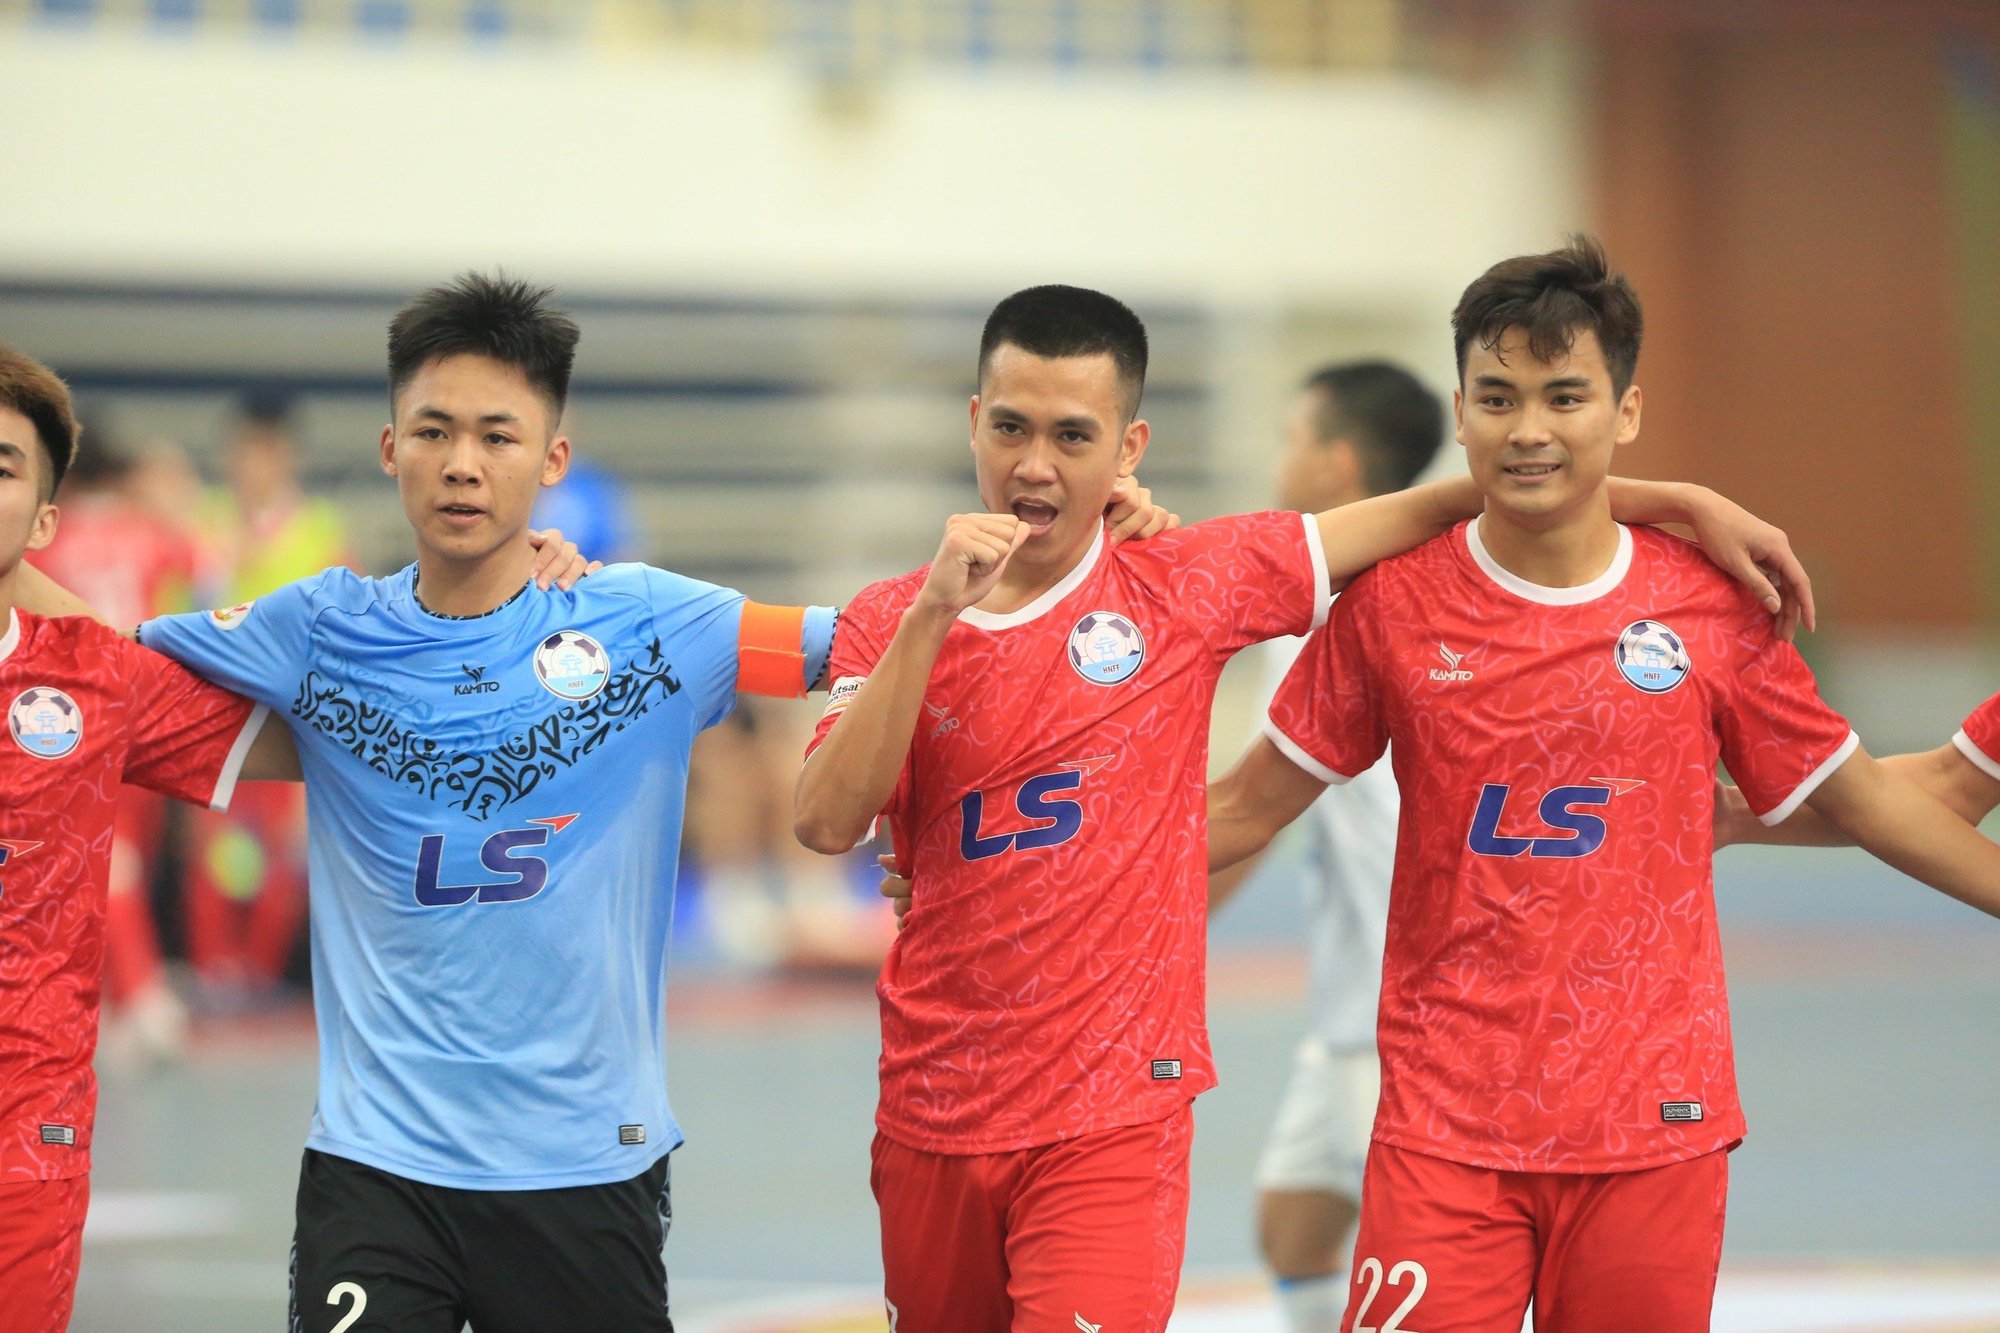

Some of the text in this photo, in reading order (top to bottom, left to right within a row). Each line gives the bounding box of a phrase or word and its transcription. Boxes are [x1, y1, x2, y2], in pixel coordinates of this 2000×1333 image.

[1102, 664, 1121, 675] HNFF
[1429, 668, 1474, 681] KAMITO
[1643, 672, 1662, 681] HNFF
[454, 681, 500, 696] KAMITO
[567, 680, 585, 689] HNFF
[832, 683, 859, 696] utsal
[931, 717, 960, 739] MITO
[960, 769, 1083, 862] LS
[1467, 782, 1611, 859] LS
[414, 827, 549, 908] LS
[1351, 1257, 1428, 1333] 22
[326, 1281, 368, 1333] 2
